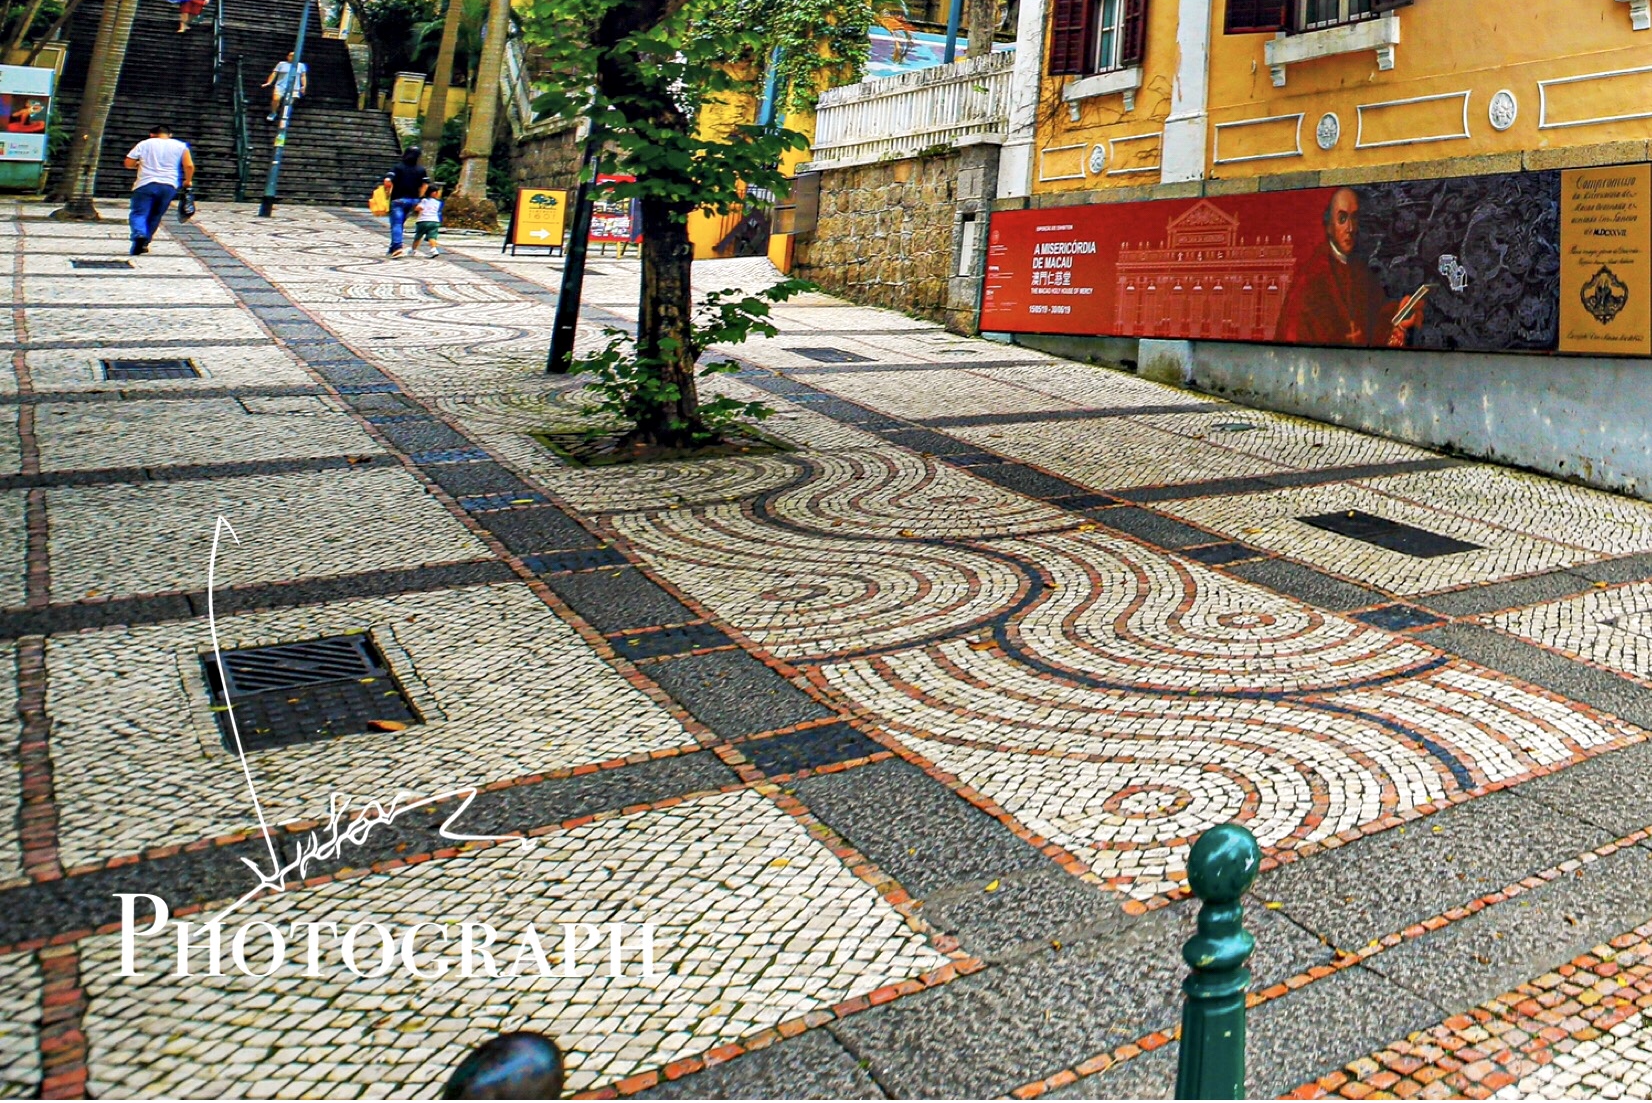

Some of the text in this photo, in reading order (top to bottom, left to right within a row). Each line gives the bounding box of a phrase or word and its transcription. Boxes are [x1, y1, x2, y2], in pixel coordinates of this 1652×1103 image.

[1033, 239, 1096, 255] A MISERICÓRDIA
[1032, 256, 1073, 269] DE MACAU
